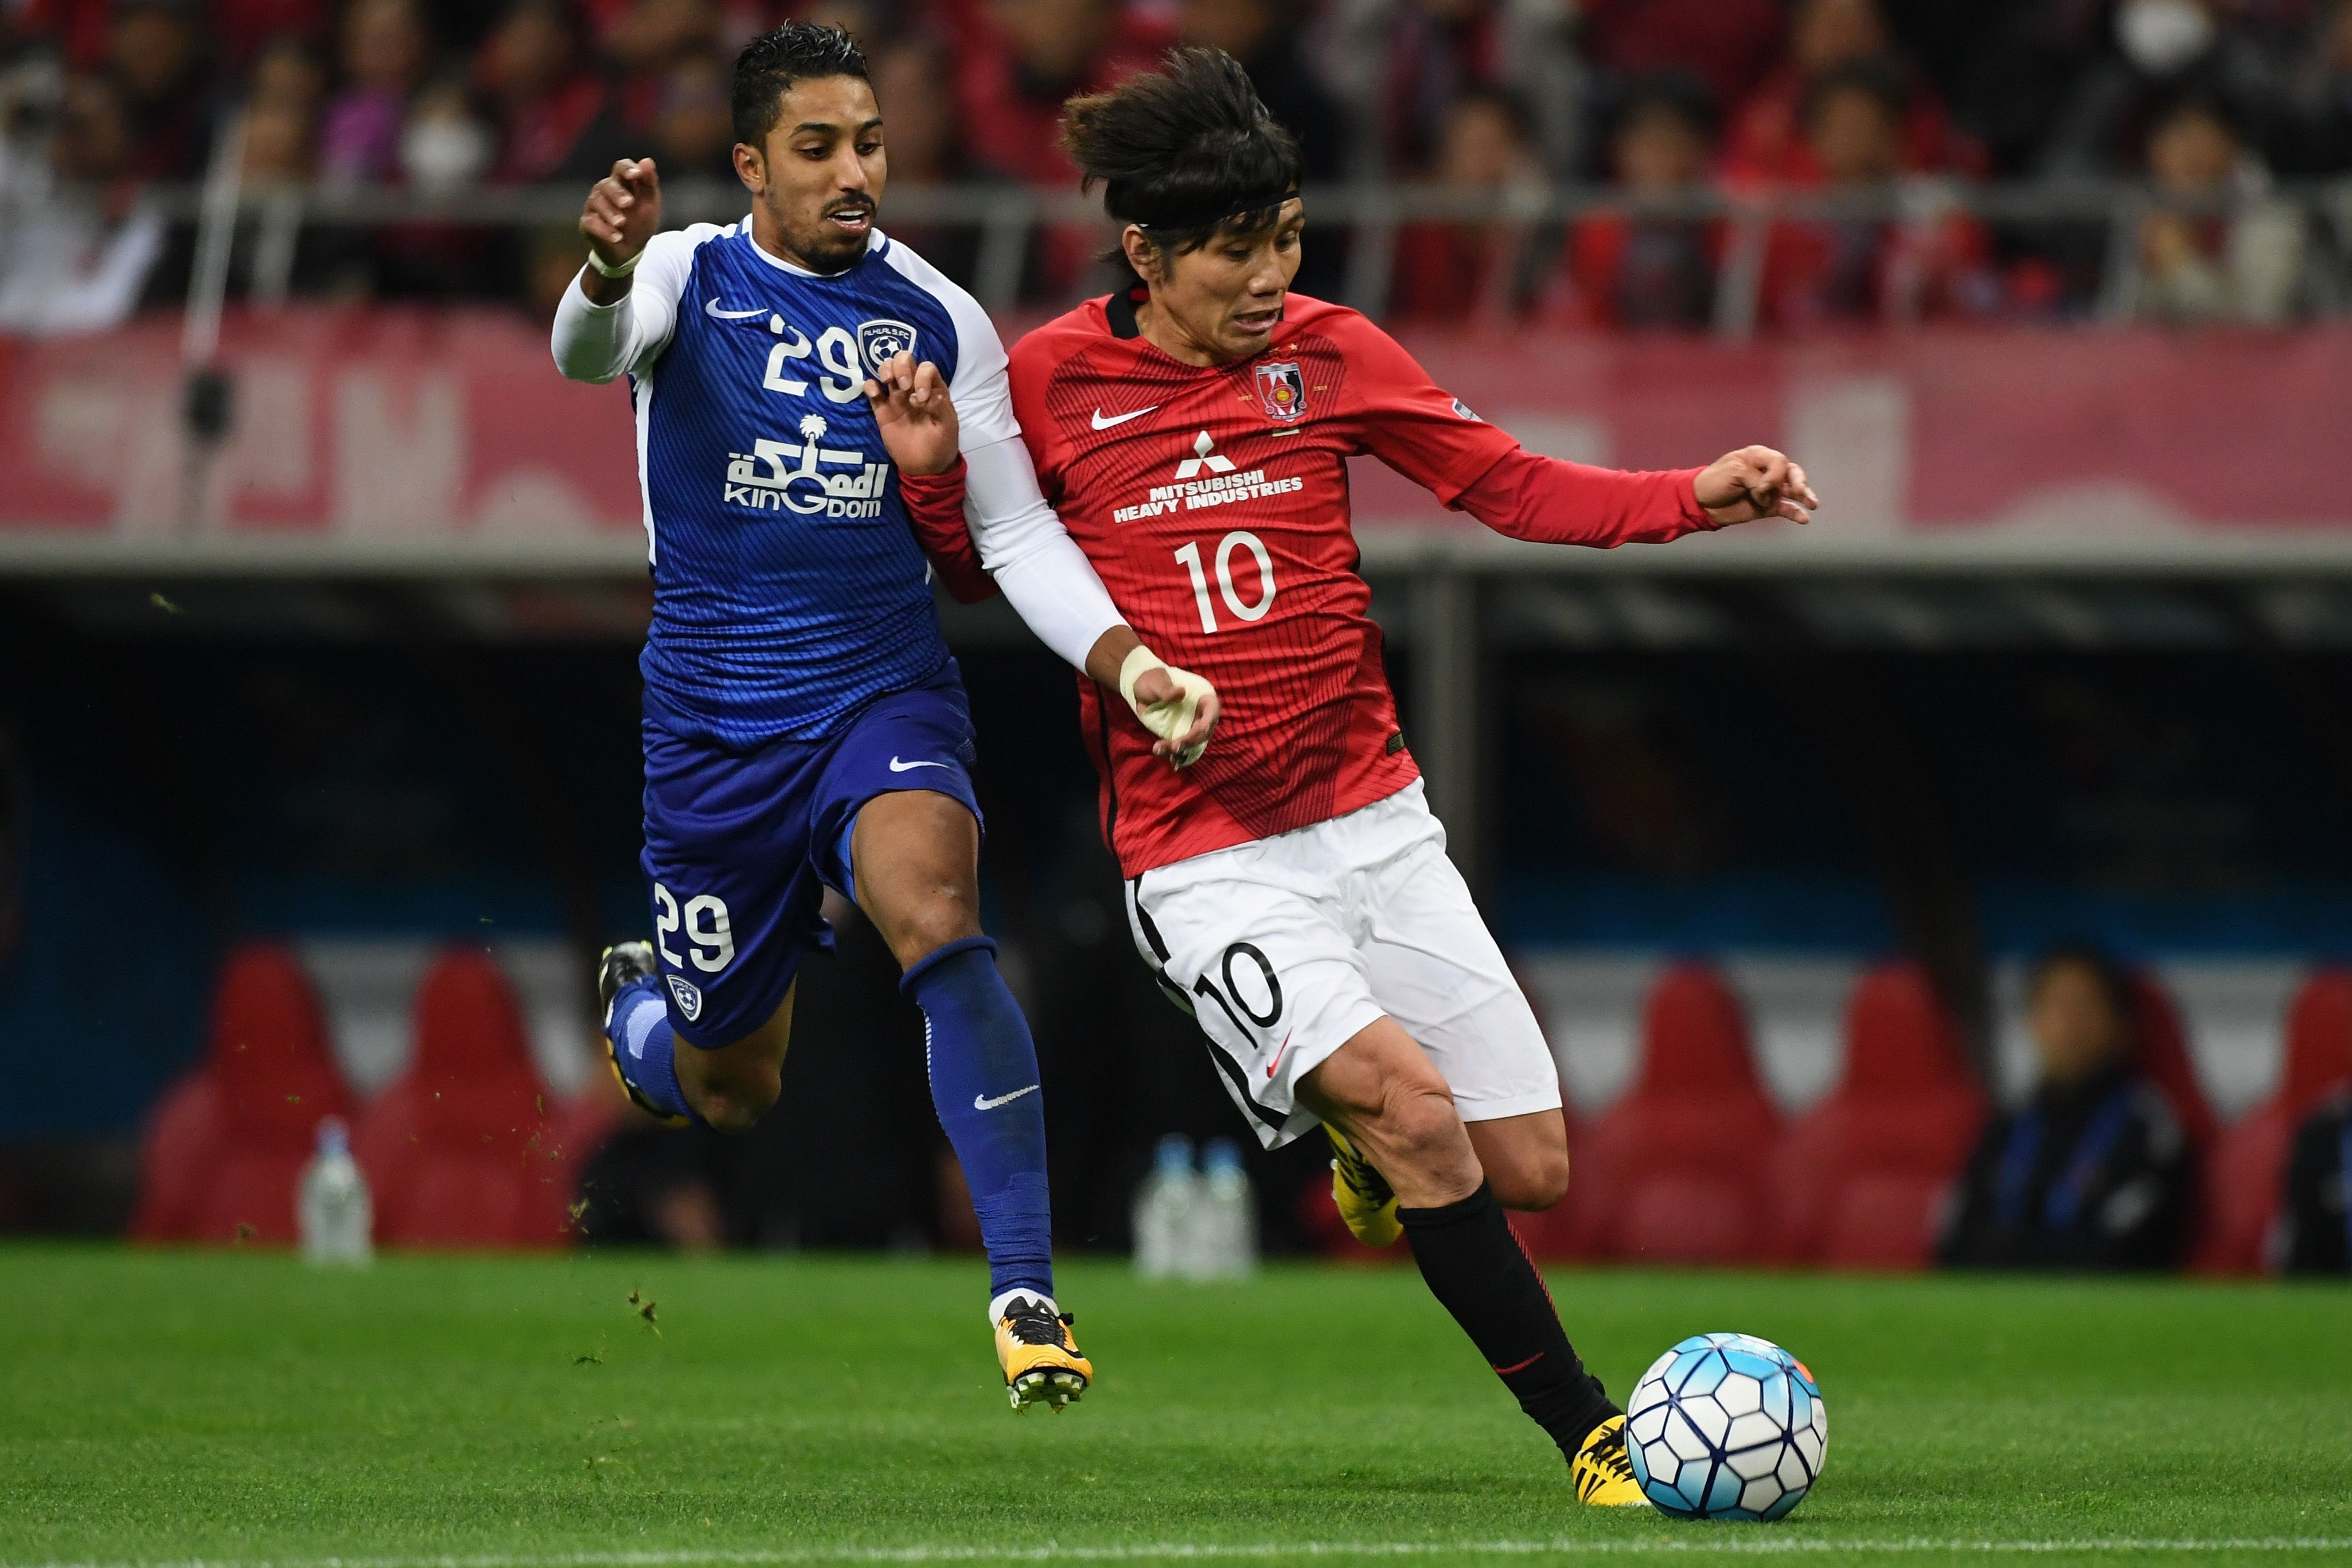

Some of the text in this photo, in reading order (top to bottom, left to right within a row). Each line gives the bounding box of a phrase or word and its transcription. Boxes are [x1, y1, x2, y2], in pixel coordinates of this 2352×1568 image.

[763, 314, 863, 403] 29
[1113, 477, 1303, 524] HEAVY INDUSTRIES
[1149, 470, 1265, 502] MITSUBISHI
[1175, 531, 1277, 634] 10
[654, 882, 735, 972] 29
[1193, 942, 1283, 1050] 10
